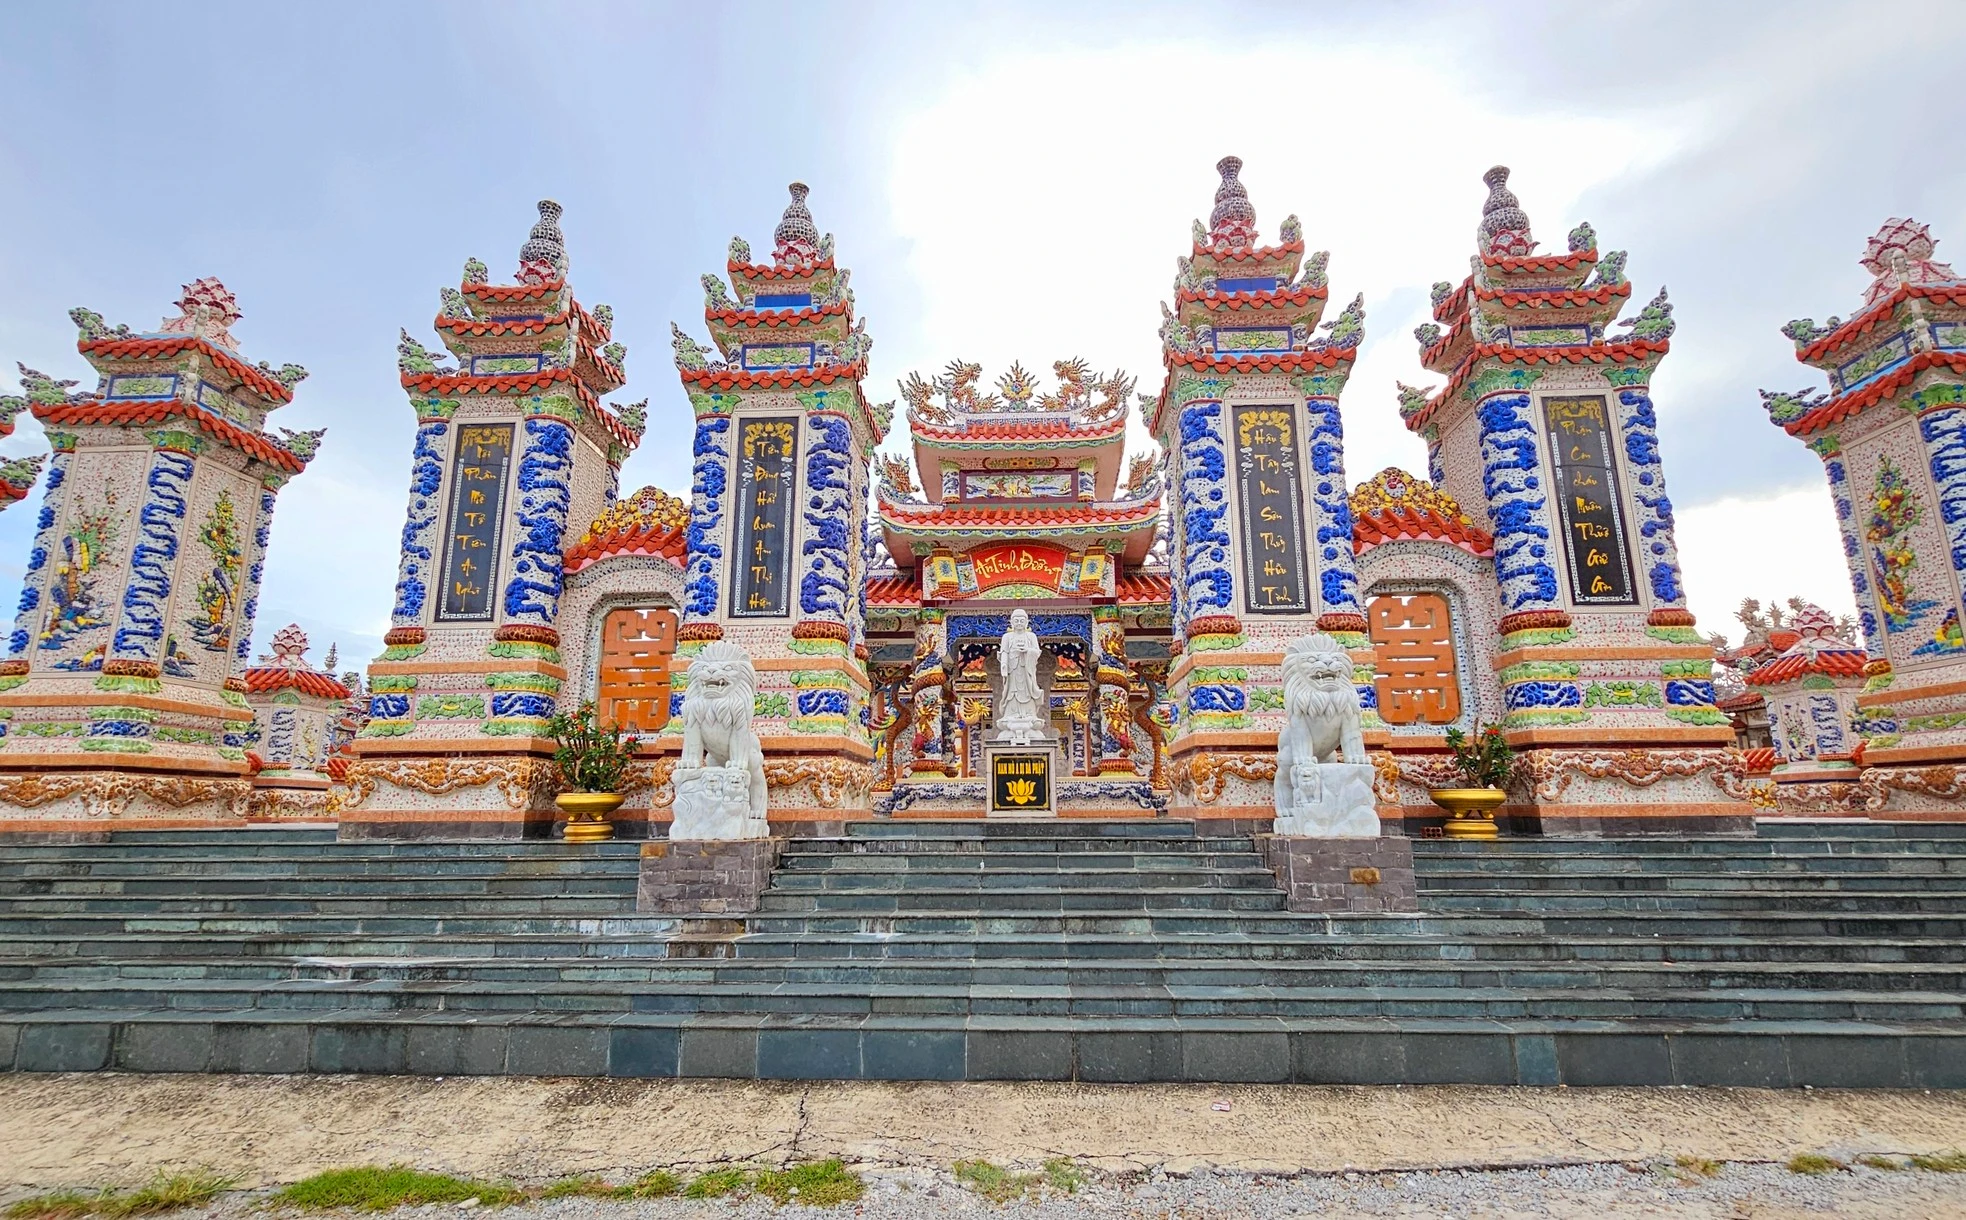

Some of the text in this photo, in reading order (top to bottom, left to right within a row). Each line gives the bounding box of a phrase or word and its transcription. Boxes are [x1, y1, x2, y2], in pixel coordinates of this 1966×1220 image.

[1254, 428, 1277, 445] Hậu
[756, 441, 780, 458] Tiền
[1570, 446, 1591, 460] Con
[1254, 454, 1280, 474] Tây
[755, 465, 780, 497] Đông
[756, 490, 776, 506] Hải
[1576, 496, 1602, 514] Muôn
[464, 512, 486, 527] Tổ
[753, 515, 776, 531] Quan
[1260, 506, 1282, 522] Sơn
[456, 534, 487, 550] Tiên
[975, 559, 994, 579] An
[985, 550, 1020, 574] Tịnh
[1586, 548, 1608, 567] Giữ
[461, 557, 478, 577] An
[751, 566, 772, 584] Thị
[1264, 559, 1287, 577] Hữu
[1262, 586, 1292, 604] Tình
